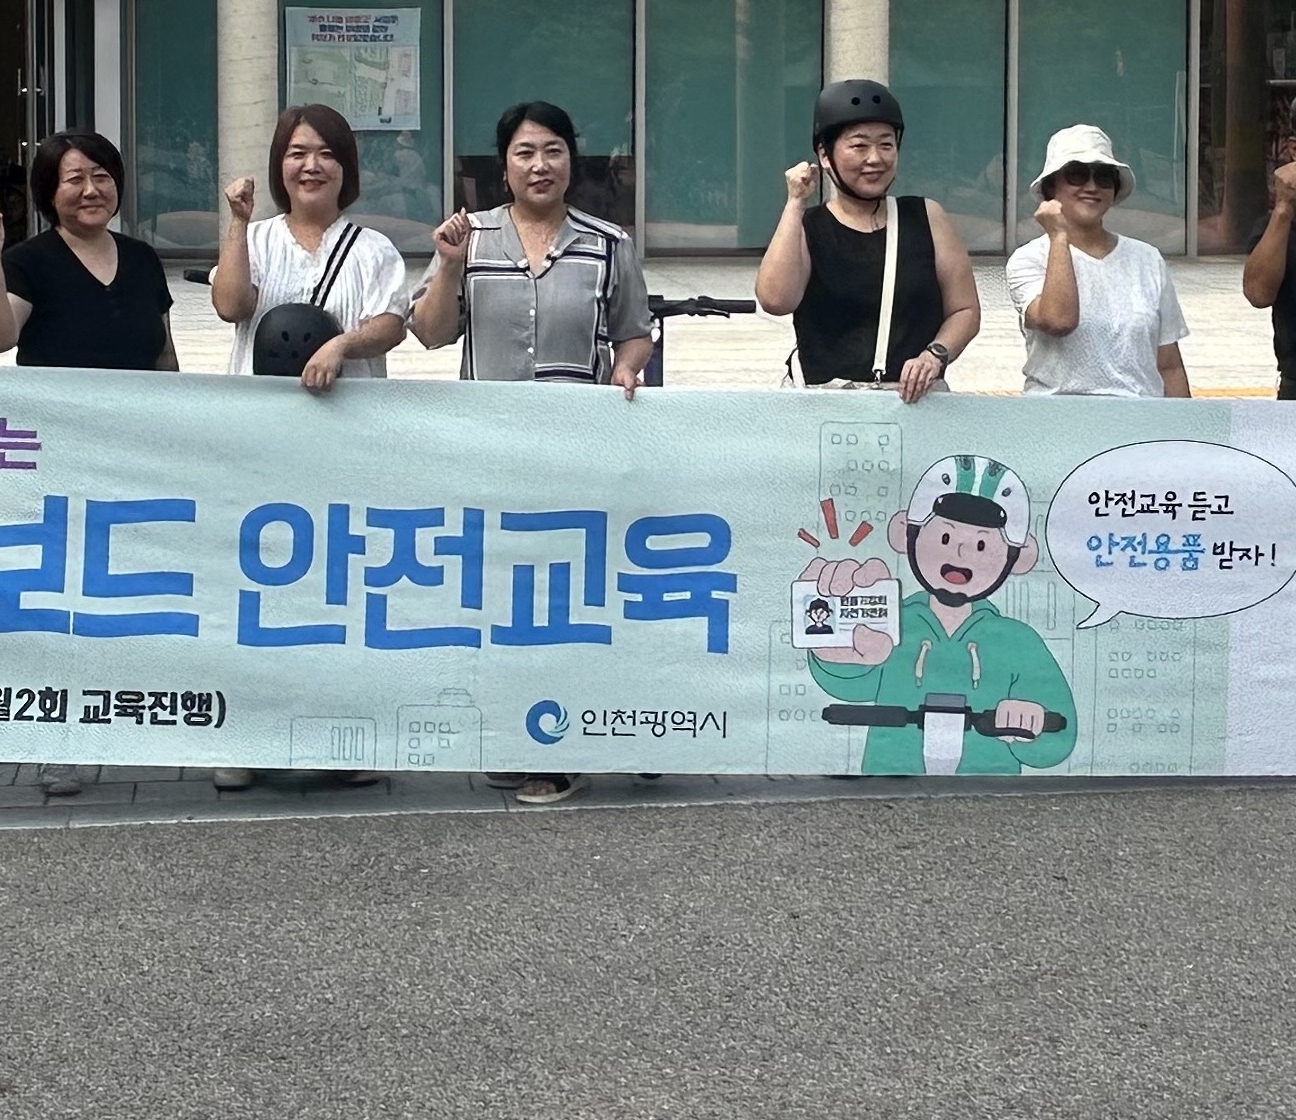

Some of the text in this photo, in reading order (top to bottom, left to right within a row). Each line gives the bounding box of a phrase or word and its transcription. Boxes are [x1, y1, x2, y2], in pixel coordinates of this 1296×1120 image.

[1087, 489, 1235, 522] 안전교육 듣고
[1086, 532, 1206, 572] 안전용품
[236, 501, 739, 656] 안전교육
[78, 689, 227, 729] 교육진행)
[581, 709, 728, 739] 인천광역시
